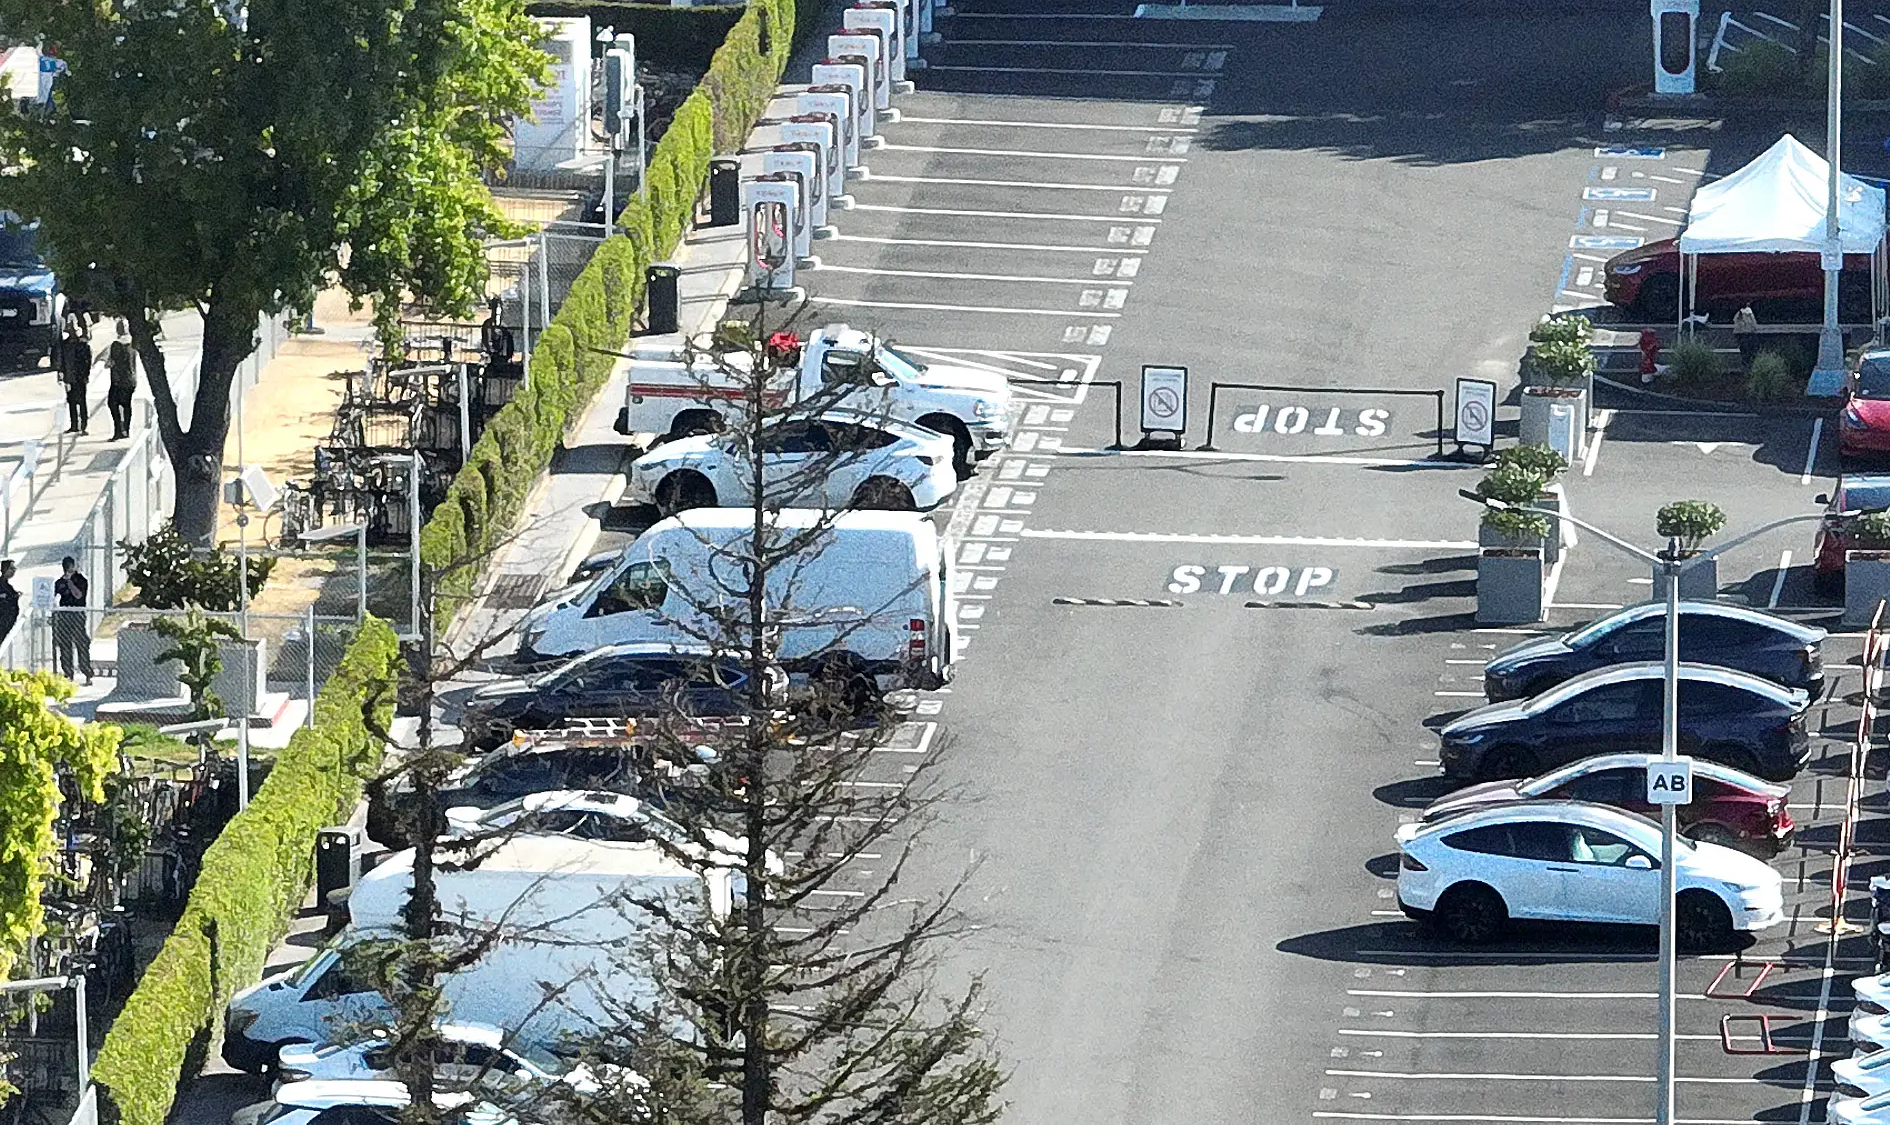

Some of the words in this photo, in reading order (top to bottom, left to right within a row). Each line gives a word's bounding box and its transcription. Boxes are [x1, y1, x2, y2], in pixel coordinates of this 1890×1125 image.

[1233, 404, 1389, 437] STOP
[1168, 565, 1332, 595] STOP
[1652, 774, 1686, 792] AB
